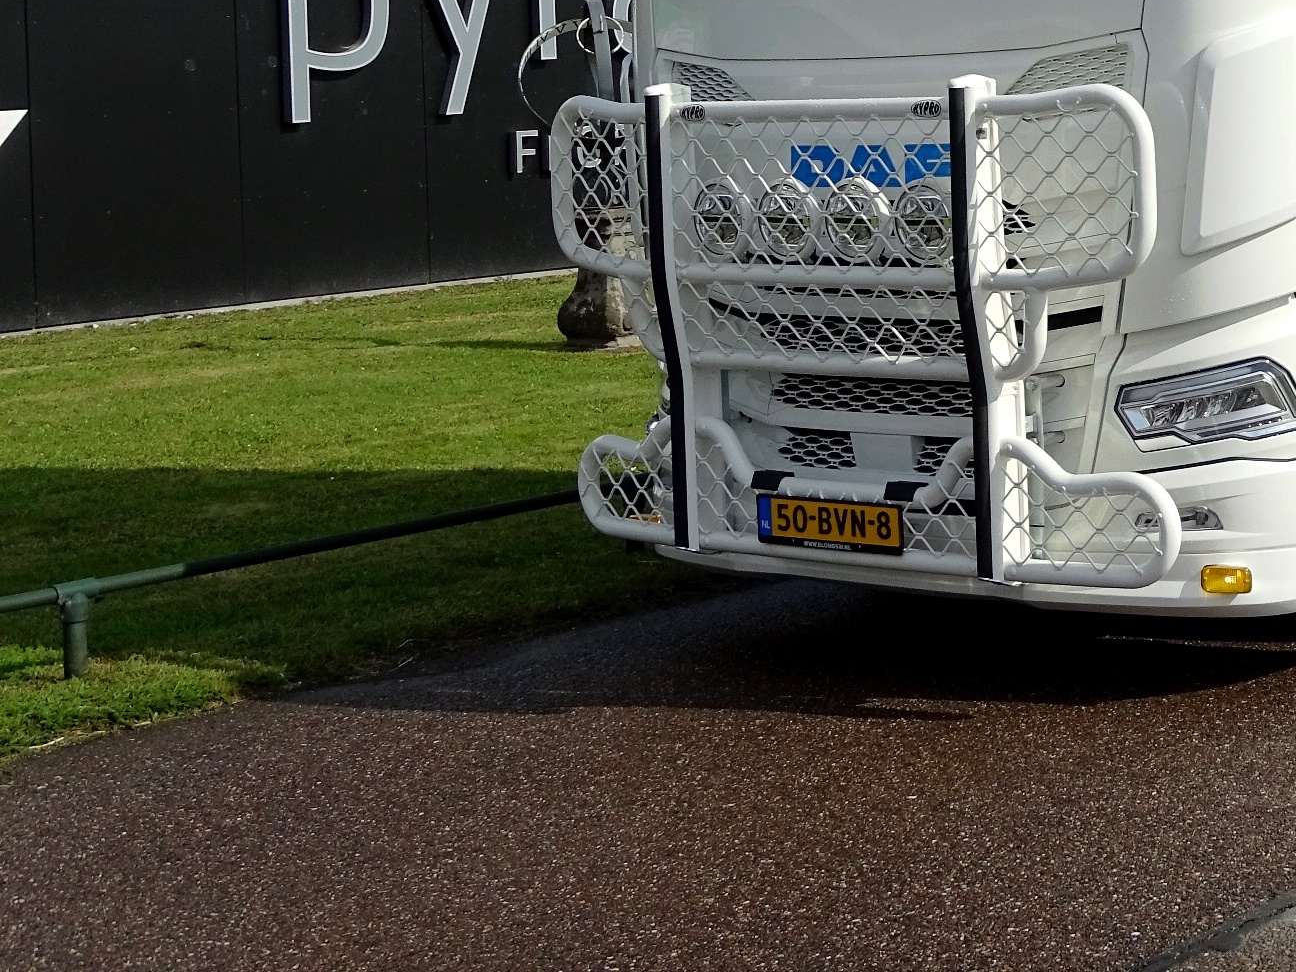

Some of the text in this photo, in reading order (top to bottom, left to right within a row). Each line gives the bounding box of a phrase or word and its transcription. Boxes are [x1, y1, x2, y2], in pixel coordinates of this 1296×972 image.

[912, 100, 940, 116] KYPRO
[761, 503, 892, 540] NL 50-BVN-8
